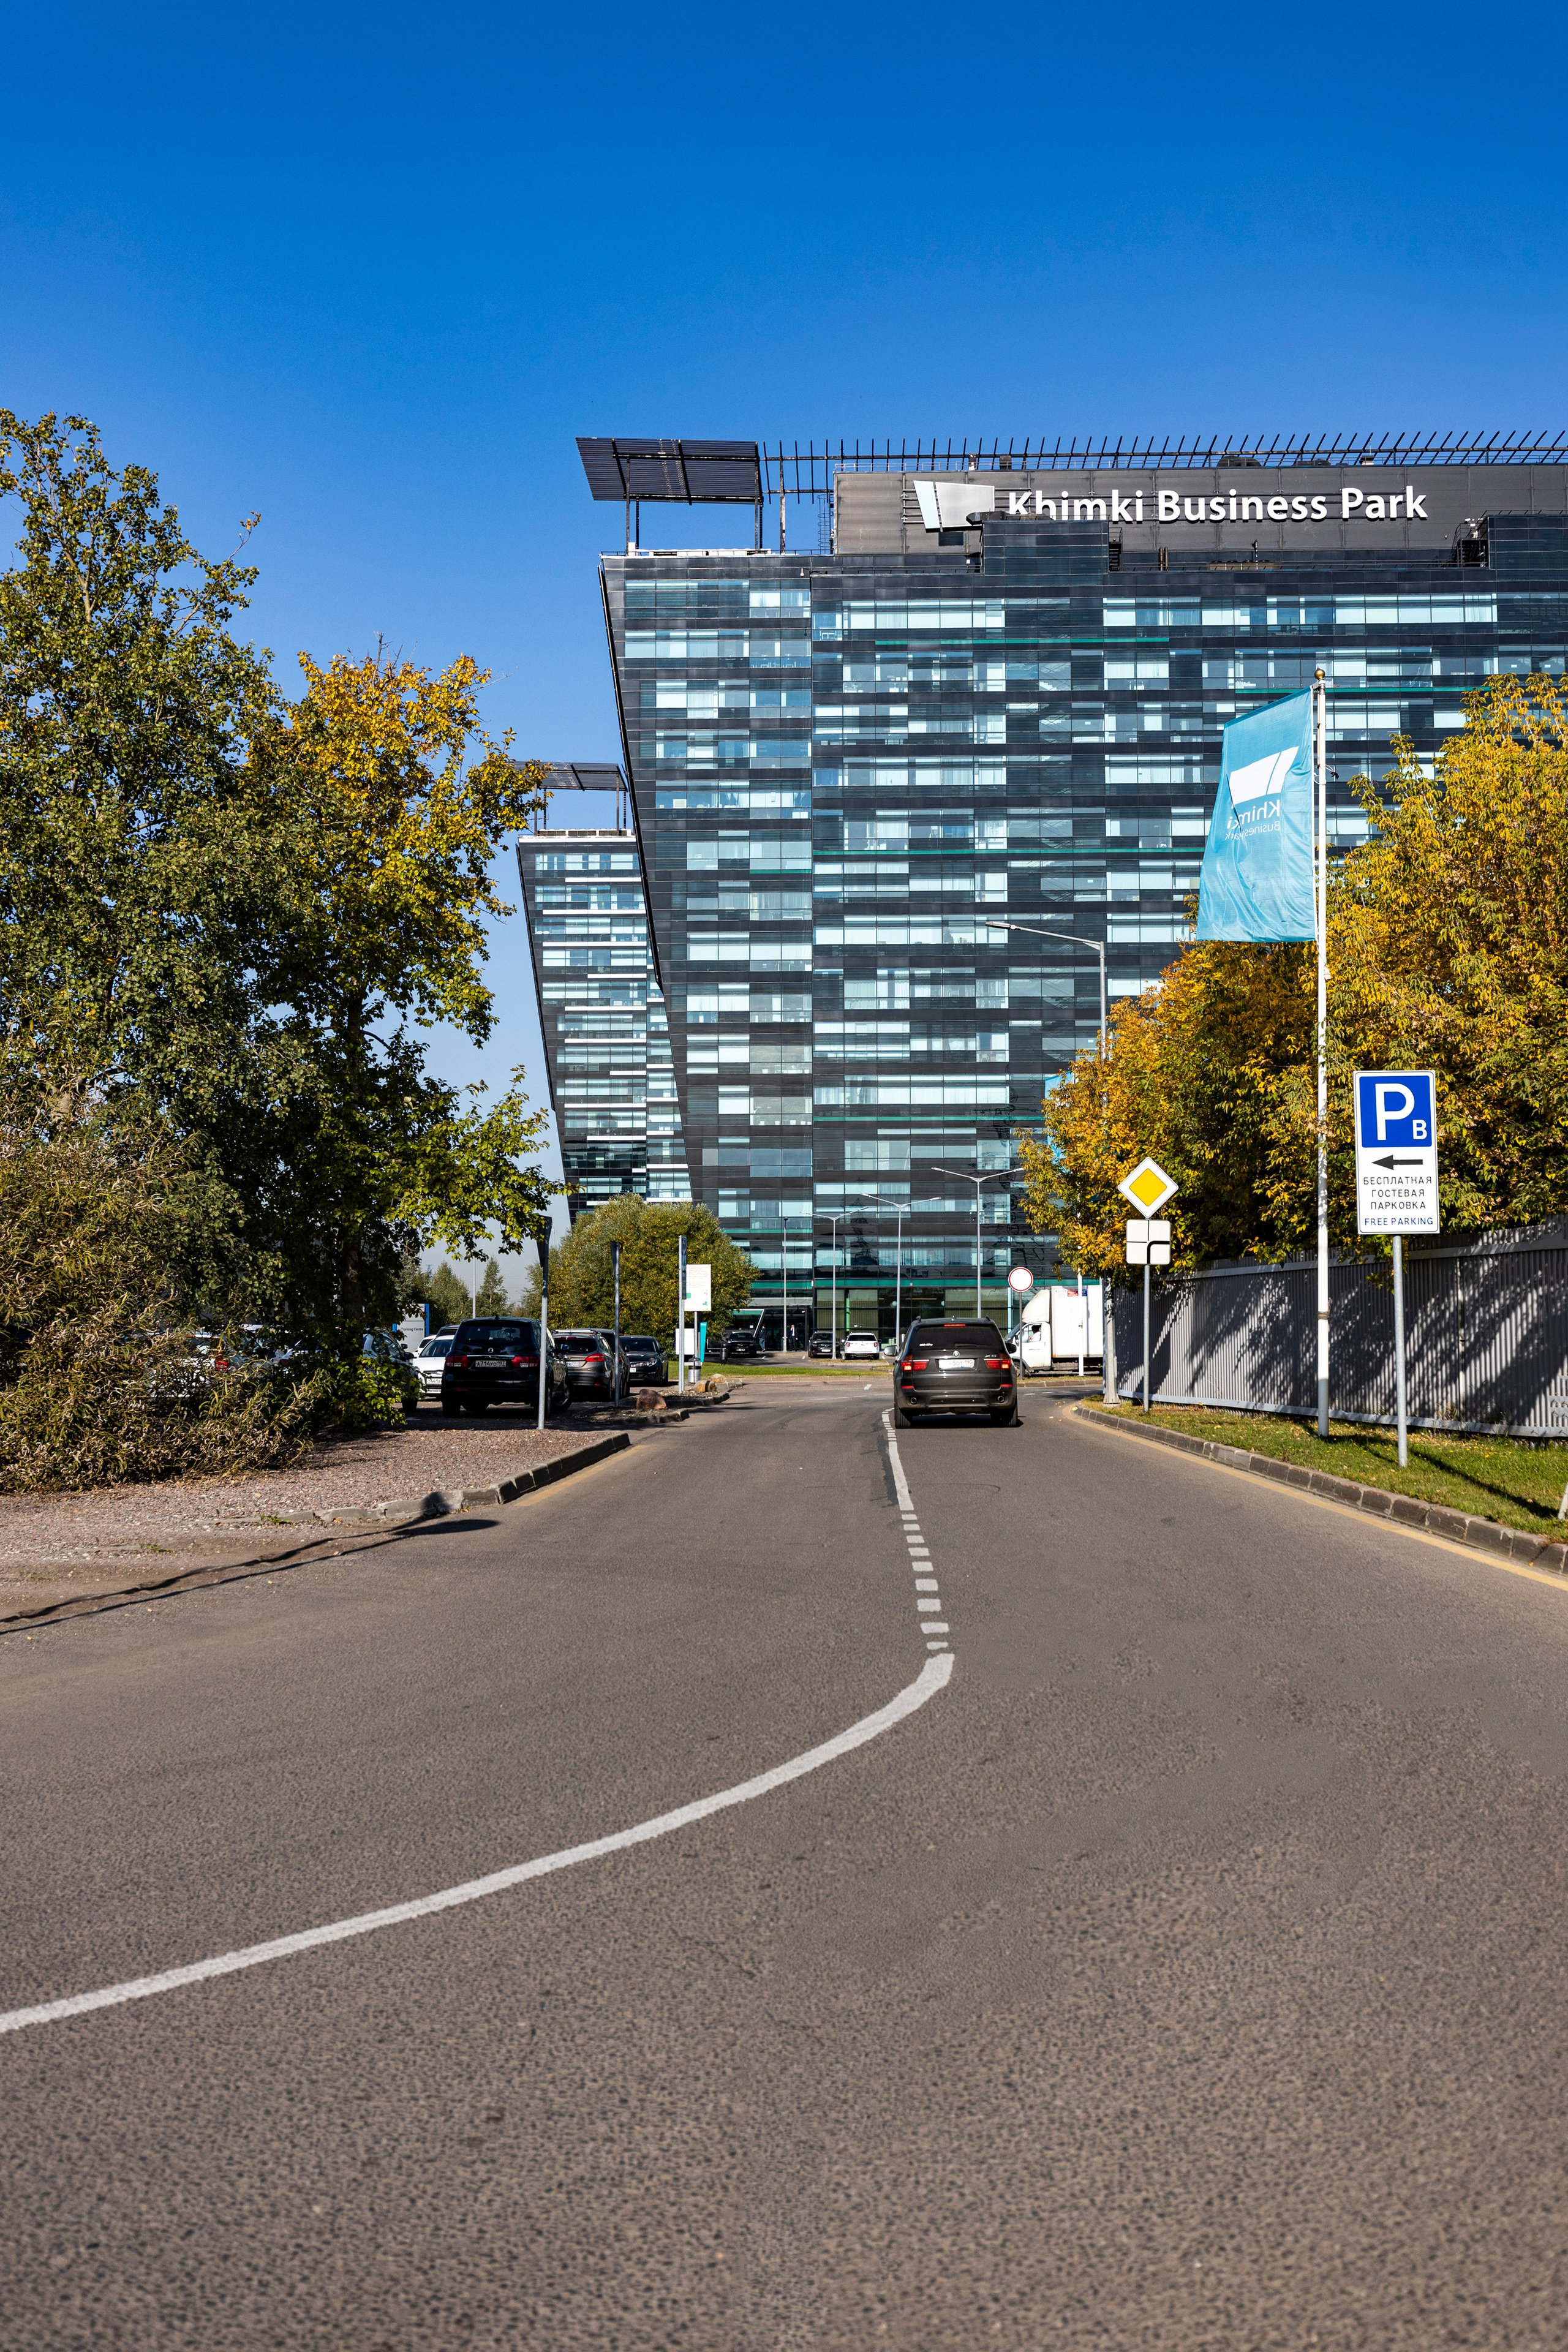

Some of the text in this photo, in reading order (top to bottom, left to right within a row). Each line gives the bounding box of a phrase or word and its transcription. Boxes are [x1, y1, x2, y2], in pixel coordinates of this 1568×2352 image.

[1009, 486, 1429, 521] Khimki Business Park
[1375, 1083, 1415, 1140] P
[1363, 1176, 1432, 1185] БЕСПЛАТНАЯ
[1371, 1189, 1425, 1197] ГОСТЕВАЯ
[1370, 1201, 1426, 1210] ПАРКОВКА
[1391, 1217, 1433, 1226] PARKING
